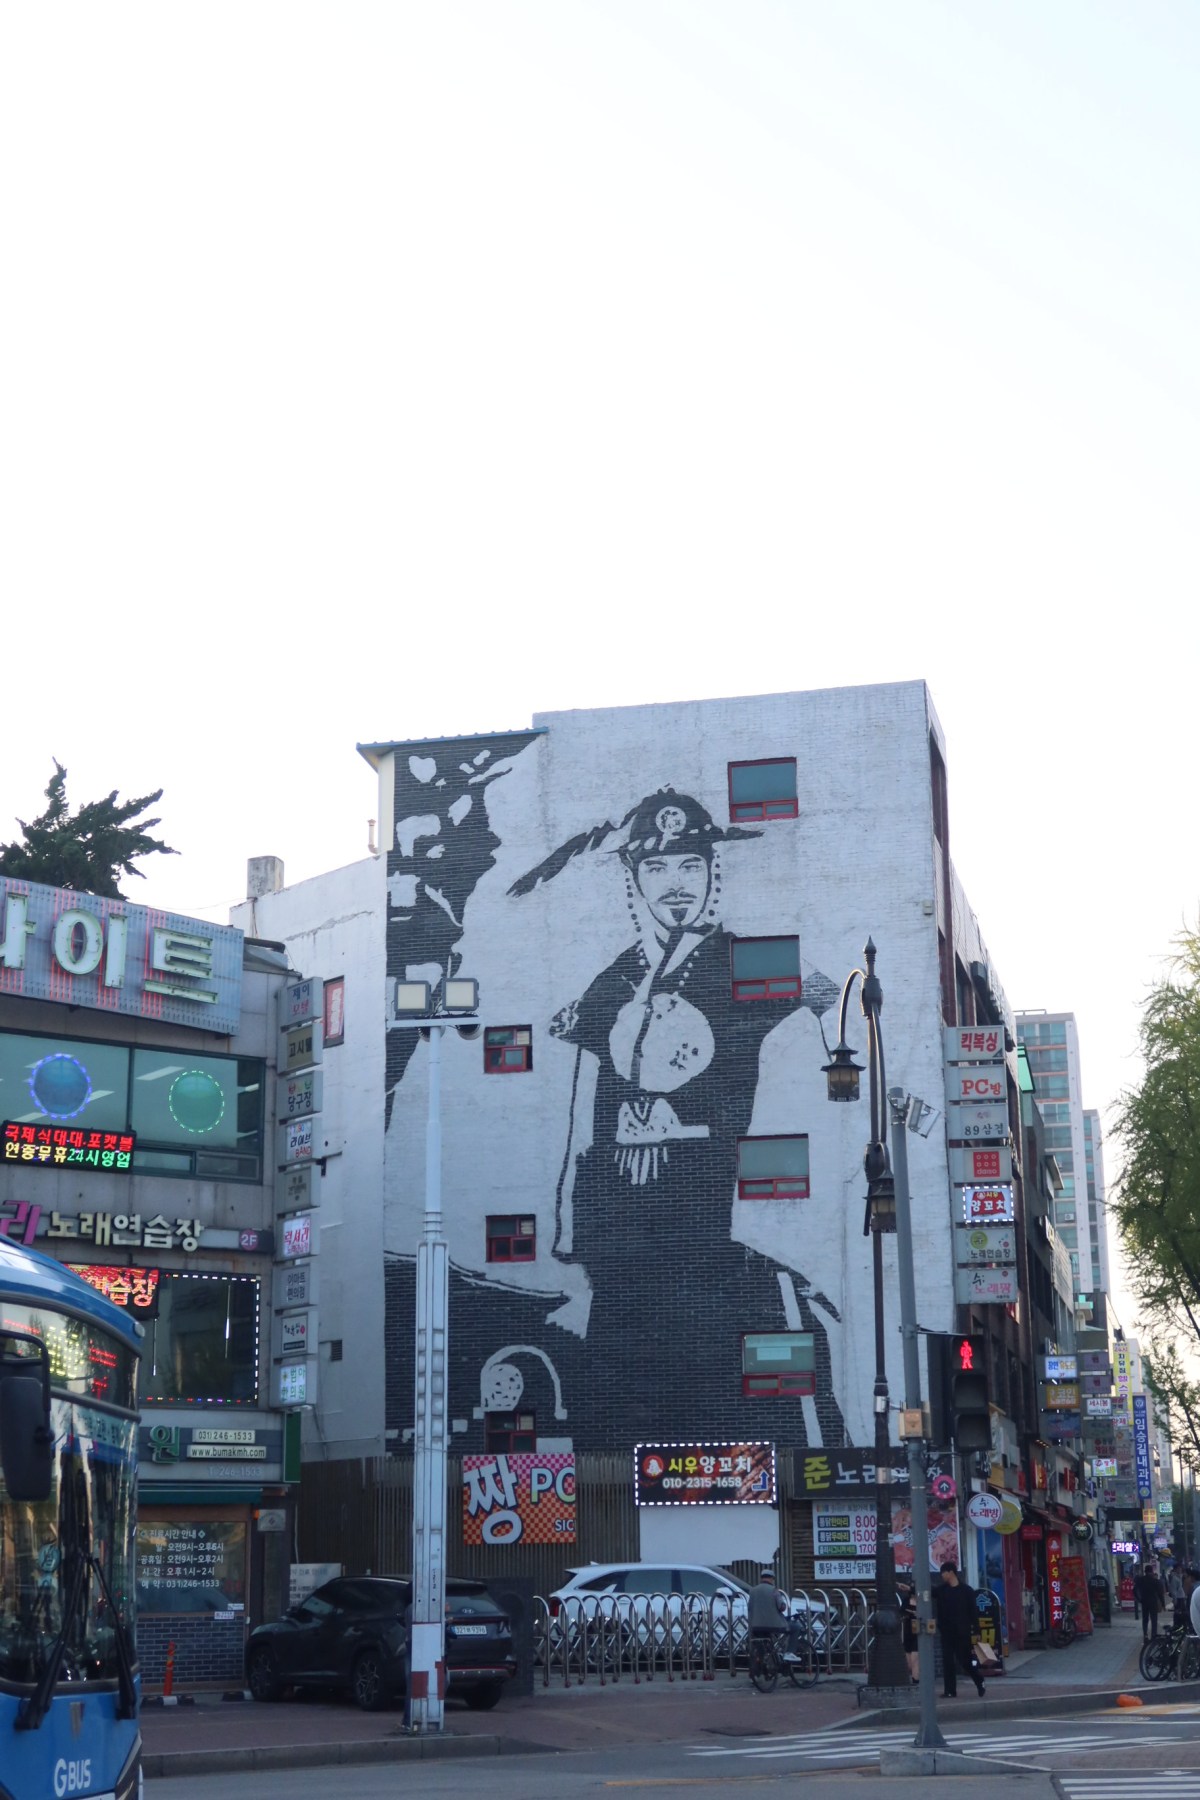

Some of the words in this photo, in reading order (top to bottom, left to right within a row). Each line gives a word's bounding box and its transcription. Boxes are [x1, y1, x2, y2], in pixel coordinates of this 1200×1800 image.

[961, 1032, 998, 1052] 킥복싱
[961, 1079, 1002, 1095] PC방
[288, 1091, 312, 1112] 당구장
[290, 1133, 311, 1148] 라이브
[295, 1146, 312, 1158] BAND
[972, 1200, 1006, 1212] 양꼬치
[47, 1211, 204, 1251] 노래연습장
[240, 1233, 257, 1246] 2F
[147, 1425, 179, 1464] 원
[191, 1447, 265, 1457] www.bumakmh.com
[1135, 1418, 1149, 1480] 임승길내과
[803, 1456, 832, 1490] 준
[662, 1477, 743, 1489] 010-2315-1658
[970, 1508, 999, 1523] 노래방
[181, 1529, 197, 1539] 안내
